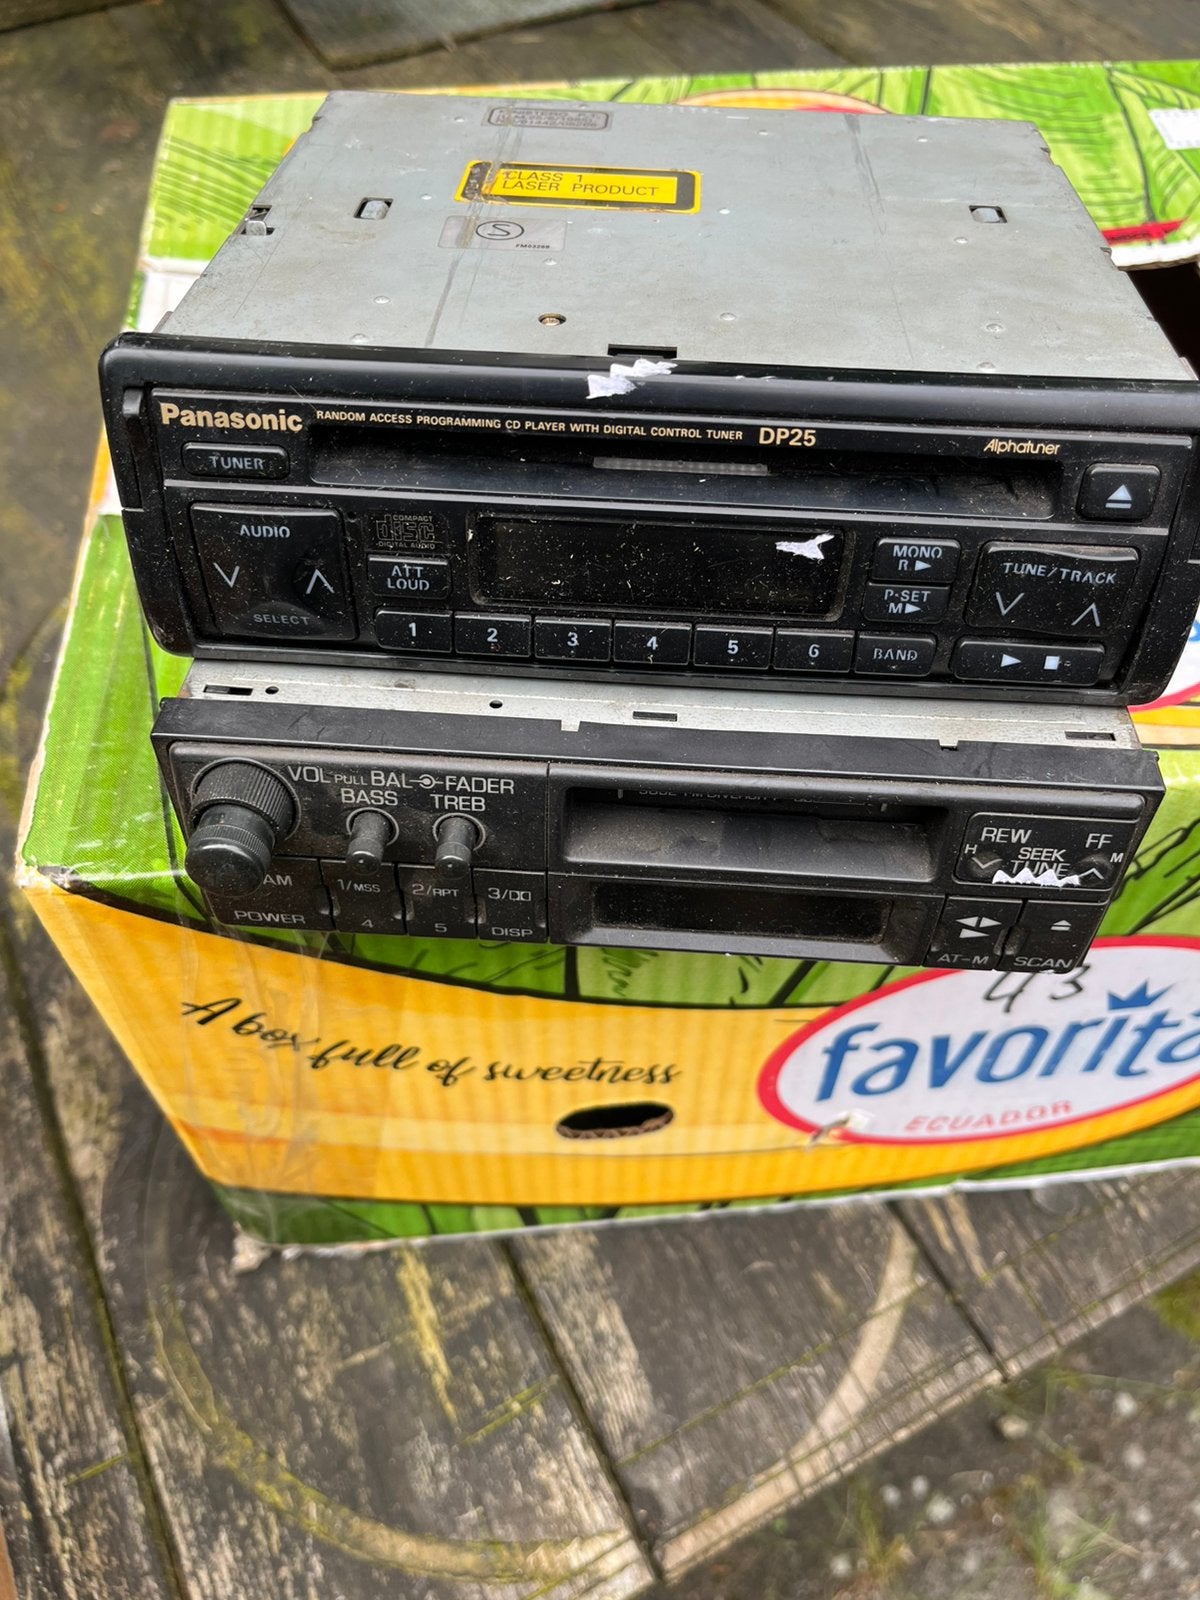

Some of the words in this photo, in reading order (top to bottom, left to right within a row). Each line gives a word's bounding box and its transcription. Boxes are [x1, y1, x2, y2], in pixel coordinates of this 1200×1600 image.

[504, 170, 563, 182] CLASS
[503, 180, 559, 192] LASER
[572, 183, 659, 196] PRODUCT
[160, 402, 303, 432] Panasonic
[316, 410, 366, 422] RANDOM
[369, 413, 412, 424] ACCESS
[416, 415, 501, 429] PROGRAMMING
[505, 420, 521, 430] CD
[525, 421, 566, 432] PLAYER
[569, 423, 600, 434] WITH
[603, 424, 647, 437] DIGITAL
[650, 427, 702, 438] CONTROL
[706, 430, 743, 441] TUNER
[758, 427, 817, 448] DP25
[983, 439, 1061, 455] Alphatuner
[208, 456, 265, 470] TUNER
[392, 514, 433, 522] COMPACT
[240, 524, 290, 539] AUDIO
[378, 541, 407, 549] DIGITAL
[893, 545, 943, 559] MONO
[391, 565, 424, 578] ATT
[898, 558, 909, 571] R
[1003, 562, 1117, 585] TUNE/TRACK
[387, 577, 430, 591] LOUD
[888, 603, 903, 615] M
[253, 613, 310, 626] SELECT
[408, 622, 417, 638] 1
[486, 627, 498, 643] 2
[567, 632, 580, 648] 3
[646, 637, 659, 652] 4
[727, 640, 739, 655] 5
[808, 644, 820, 660] 6
[873, 648, 918, 662] BAND
[287, 765, 331, 785] VOL
[334, 774, 368, 786] PULL
[370, 770, 413, 790] BAL
[445, 775, 515, 795] FADER
[341, 788, 399, 807] BASS
[430, 793, 486, 812] TREB
[981, 826, 1032, 844] REW
[1085, 833, 1113, 849] FF
[964, 843, 978, 855] H
[1017, 846, 1067, 862] SEEK
[1110, 852, 1124, 863] M
[1010, 859, 1071, 878] TUNE
[234, 909, 306, 924] POWER
[361, 918, 373, 929] 4
[435, 924, 447, 933] 5
[491, 926, 534, 938] DISP
[937, 953, 990, 965] AT-M
[1013, 956, 1073, 969] SCAN
[182, 997, 242, 1027] A
[232, 1012, 321, 1052] box
[309, 1038, 421, 1070] full
[427, 1055, 475, 1087] of
[484, 1057, 684, 1083] sweetness
[814, 1008, 1200, 1102] favorita
[904, 1100, 1073, 1133] ECUADOR
